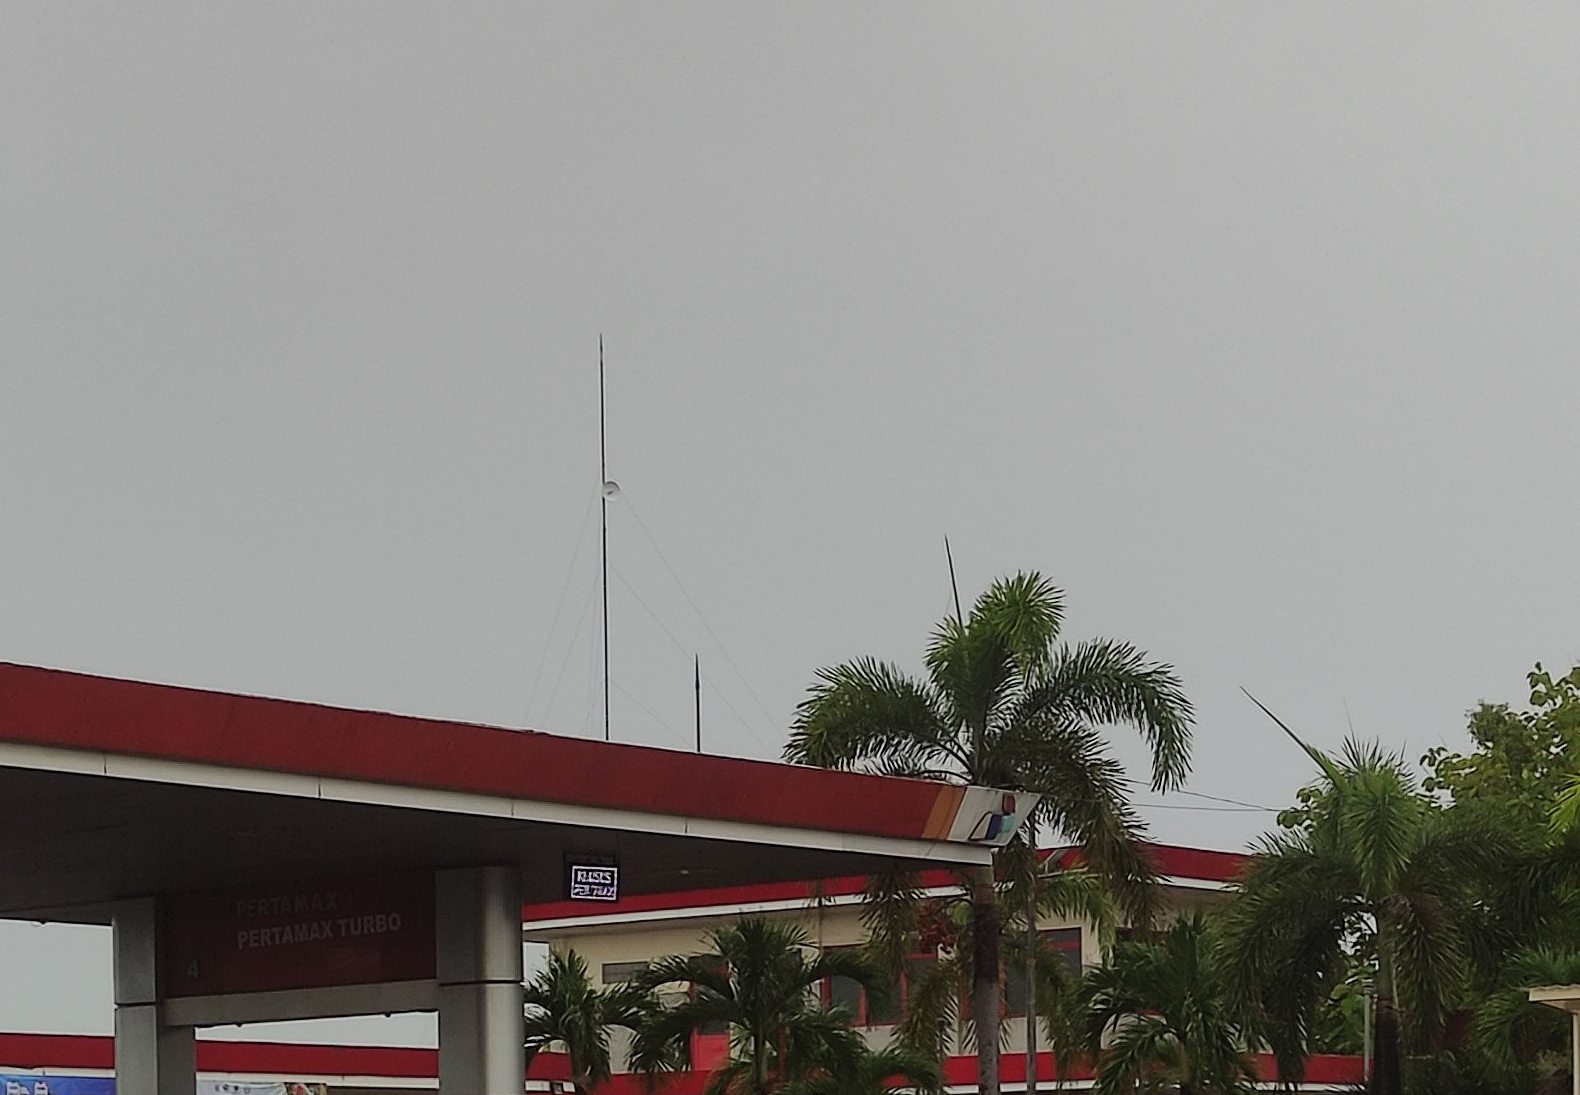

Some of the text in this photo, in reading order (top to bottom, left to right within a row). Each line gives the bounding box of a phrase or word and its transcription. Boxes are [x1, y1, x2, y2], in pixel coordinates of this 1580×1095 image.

[236, 891, 338, 918] PERTAMAX
[237, 913, 402, 950] PERTAMAX TURBO
[187, 959, 199, 979] 4
